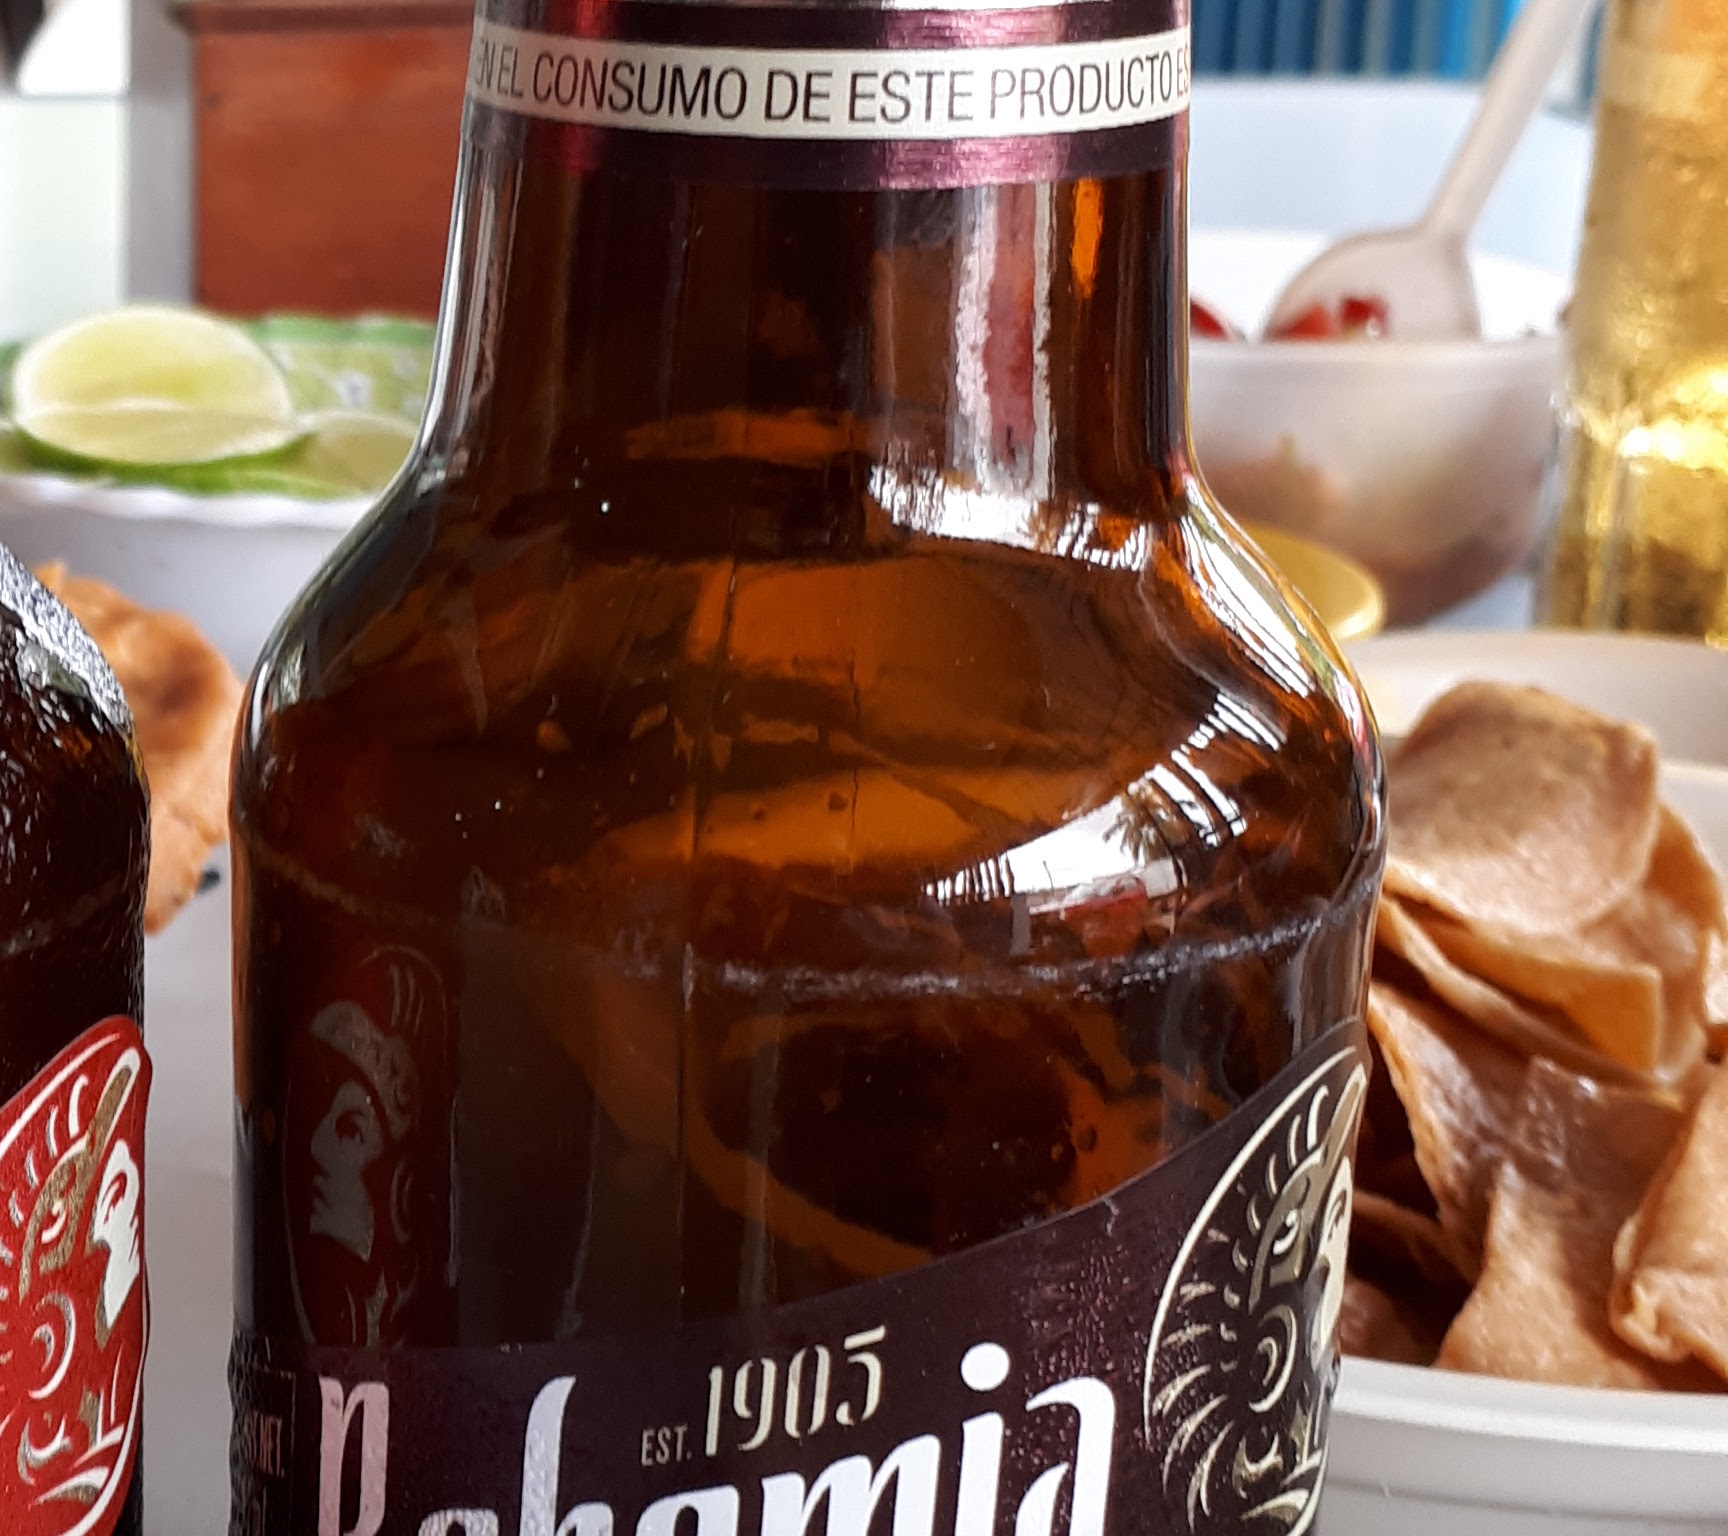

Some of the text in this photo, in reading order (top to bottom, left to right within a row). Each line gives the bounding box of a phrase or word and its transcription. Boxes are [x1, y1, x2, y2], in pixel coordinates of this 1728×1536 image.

[496, 44, 525, 99] EL
[532, 51, 749, 122] CONSUMO
[763, 68, 832, 124] DE
[847, 68, 975, 125] ESTE
[988, 50, 1173, 121] PRODUCTO
[640, 1323, 887, 1467] EST. 1905
